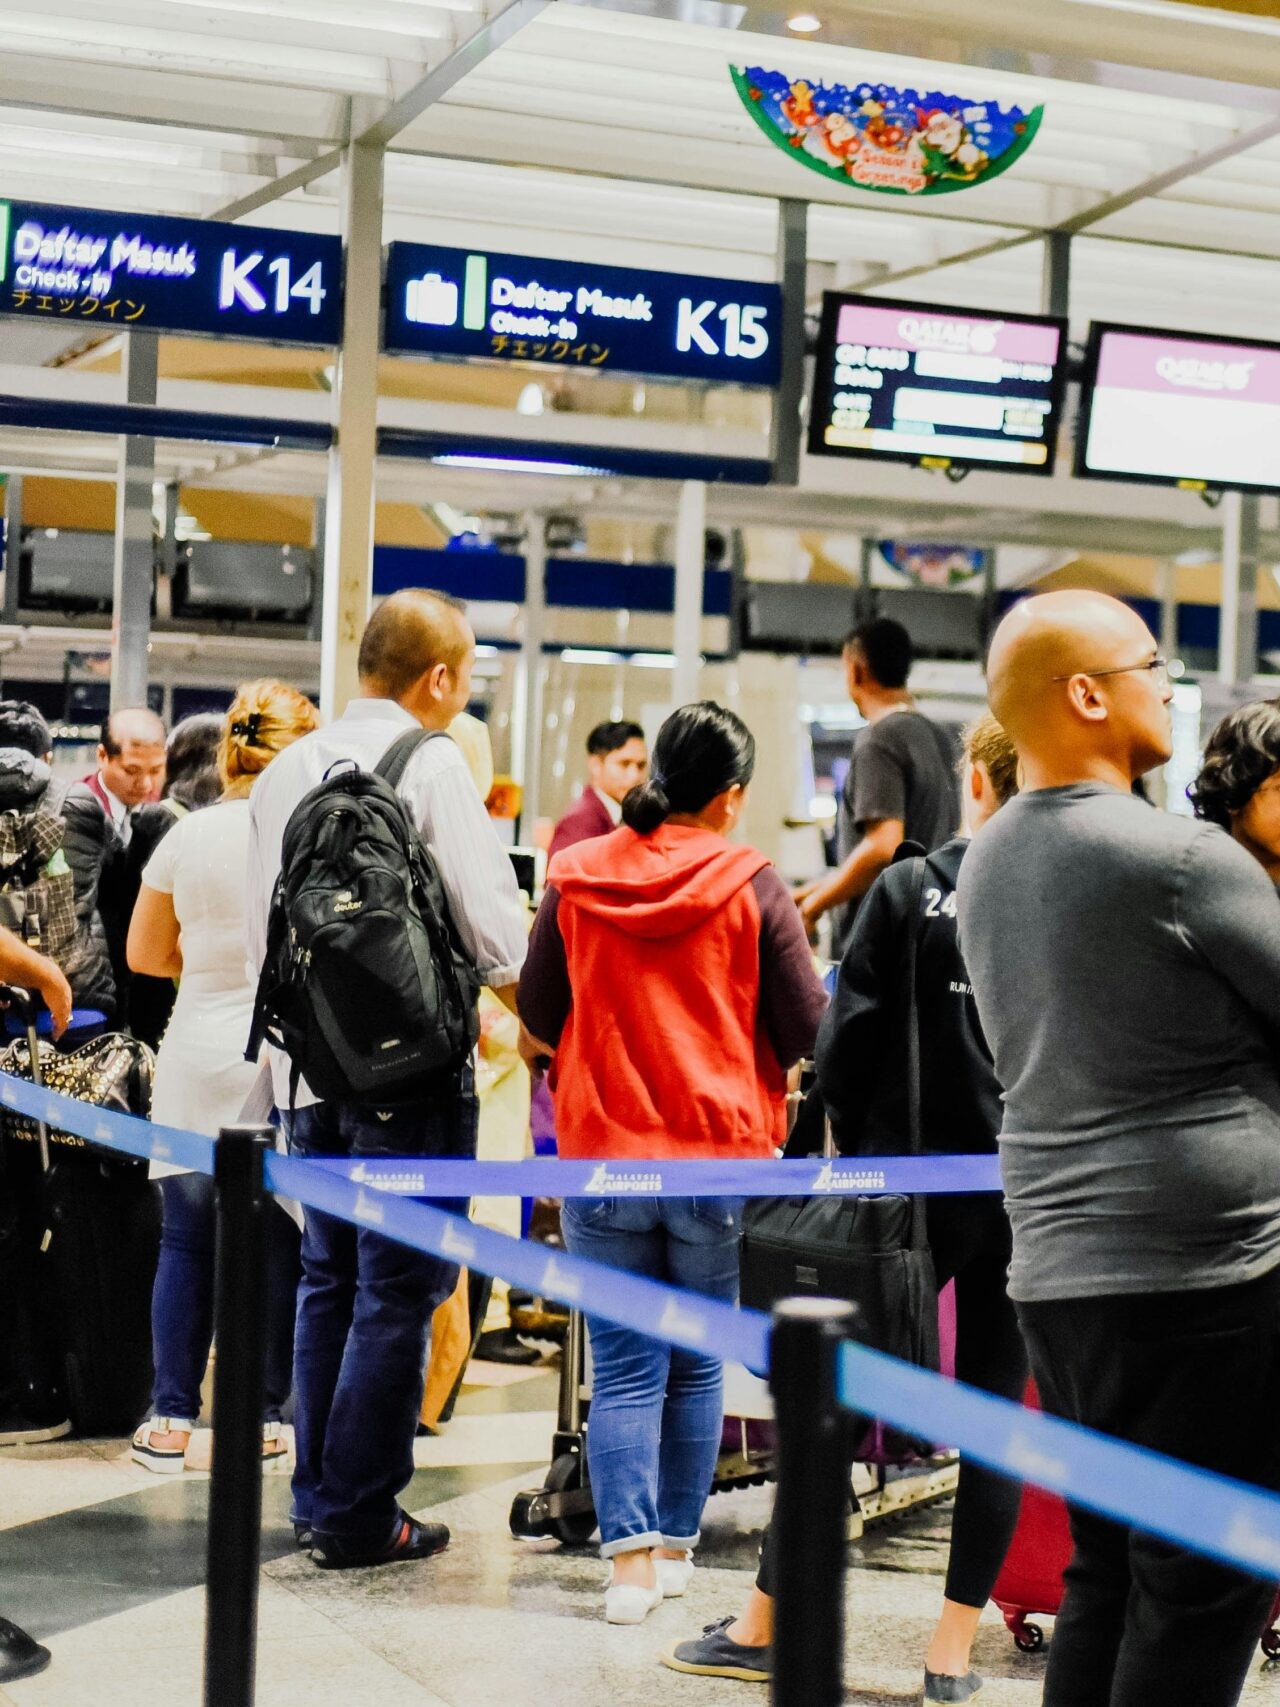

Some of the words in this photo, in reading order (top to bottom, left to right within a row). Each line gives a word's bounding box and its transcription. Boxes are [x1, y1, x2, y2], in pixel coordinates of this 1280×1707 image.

[15, 223, 107, 267] Daftar
[111, 234, 197, 275] Masuk
[218, 250, 326, 315] K14
[675, 297, 769, 360] K15
[831, 1178, 886, 1189] AIRPORTS
[832, 1171, 885, 1179] MALAYSIA
